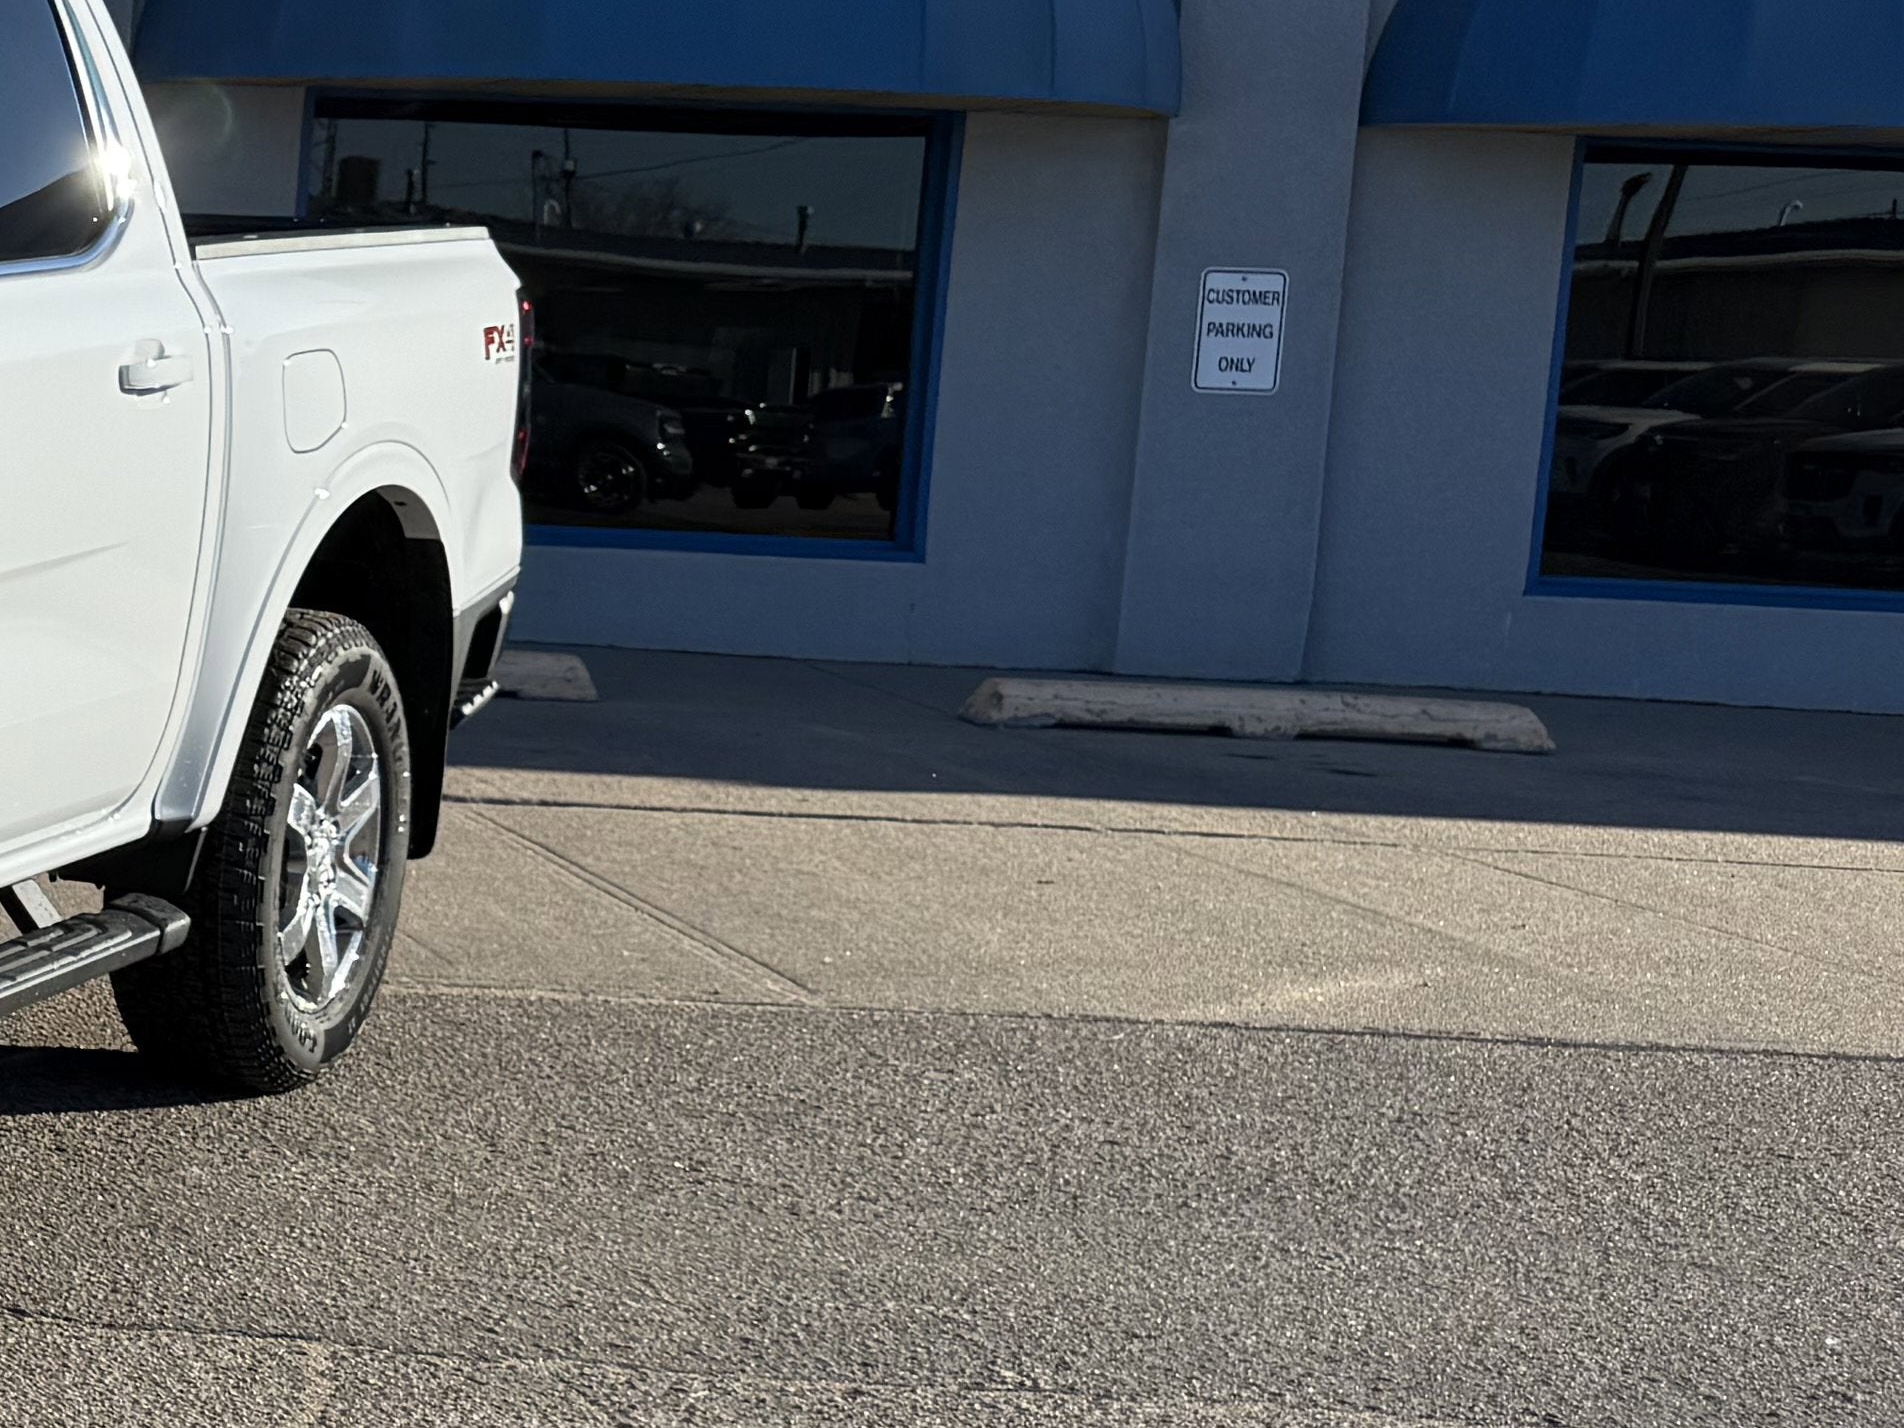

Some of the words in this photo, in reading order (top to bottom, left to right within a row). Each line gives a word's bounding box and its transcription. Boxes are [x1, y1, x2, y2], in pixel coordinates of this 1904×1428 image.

[1206, 288, 1281, 307] CUSTOMER
[1206, 321, 1274, 340] PARKING
[1218, 355, 1255, 373] ONLY
